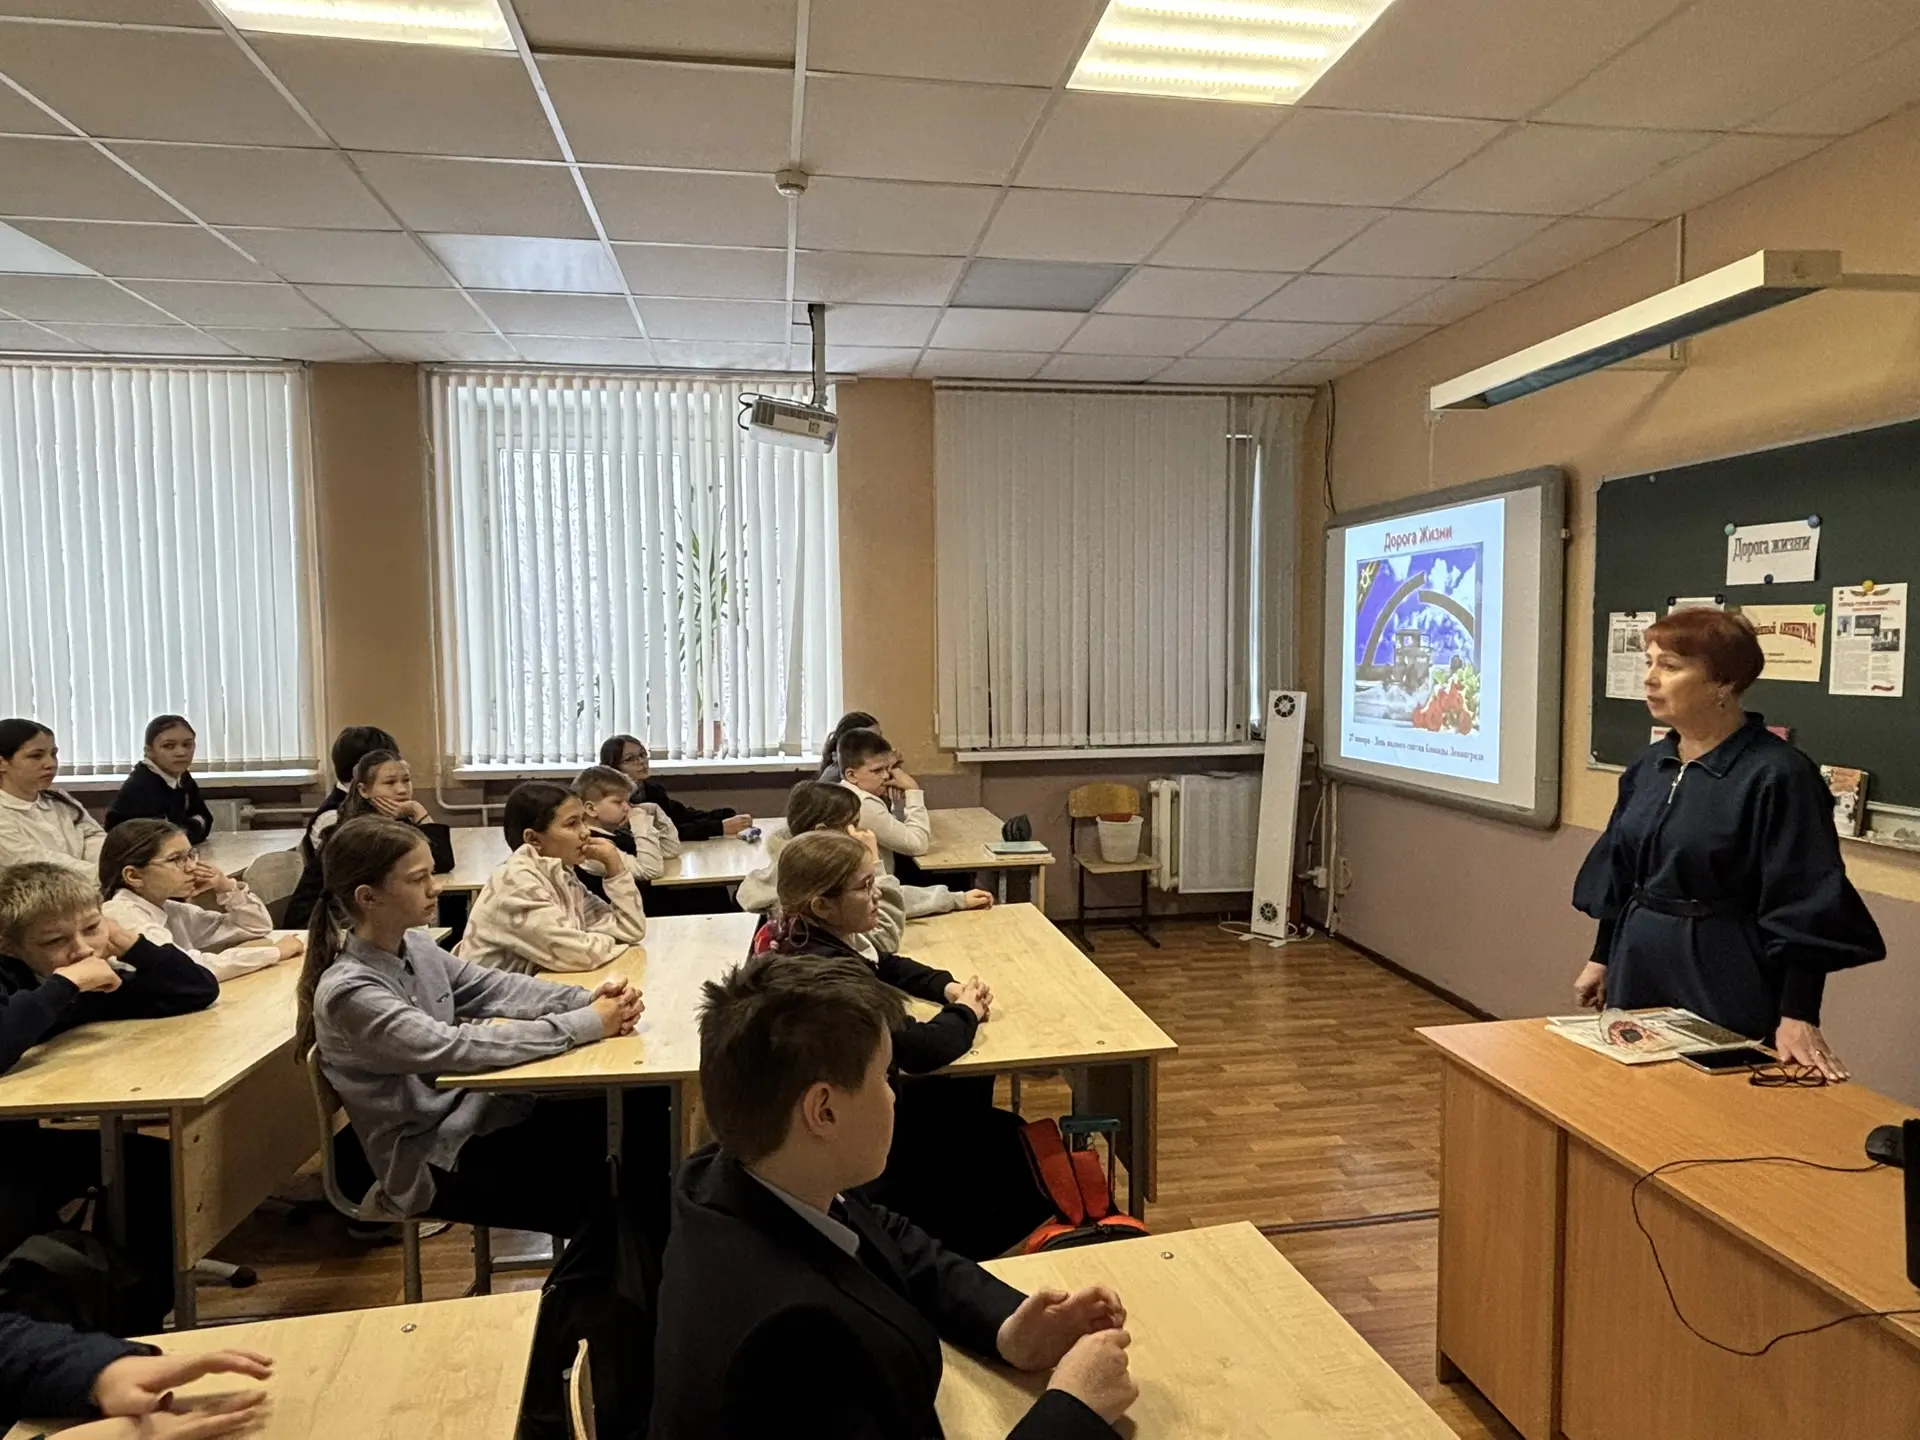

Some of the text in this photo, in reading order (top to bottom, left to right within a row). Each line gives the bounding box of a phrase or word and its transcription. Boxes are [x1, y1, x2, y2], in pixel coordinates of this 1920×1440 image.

[1384, 525, 1452, 552] Дорога Жизни
[1733, 535, 1811, 562] Дорога жизни
